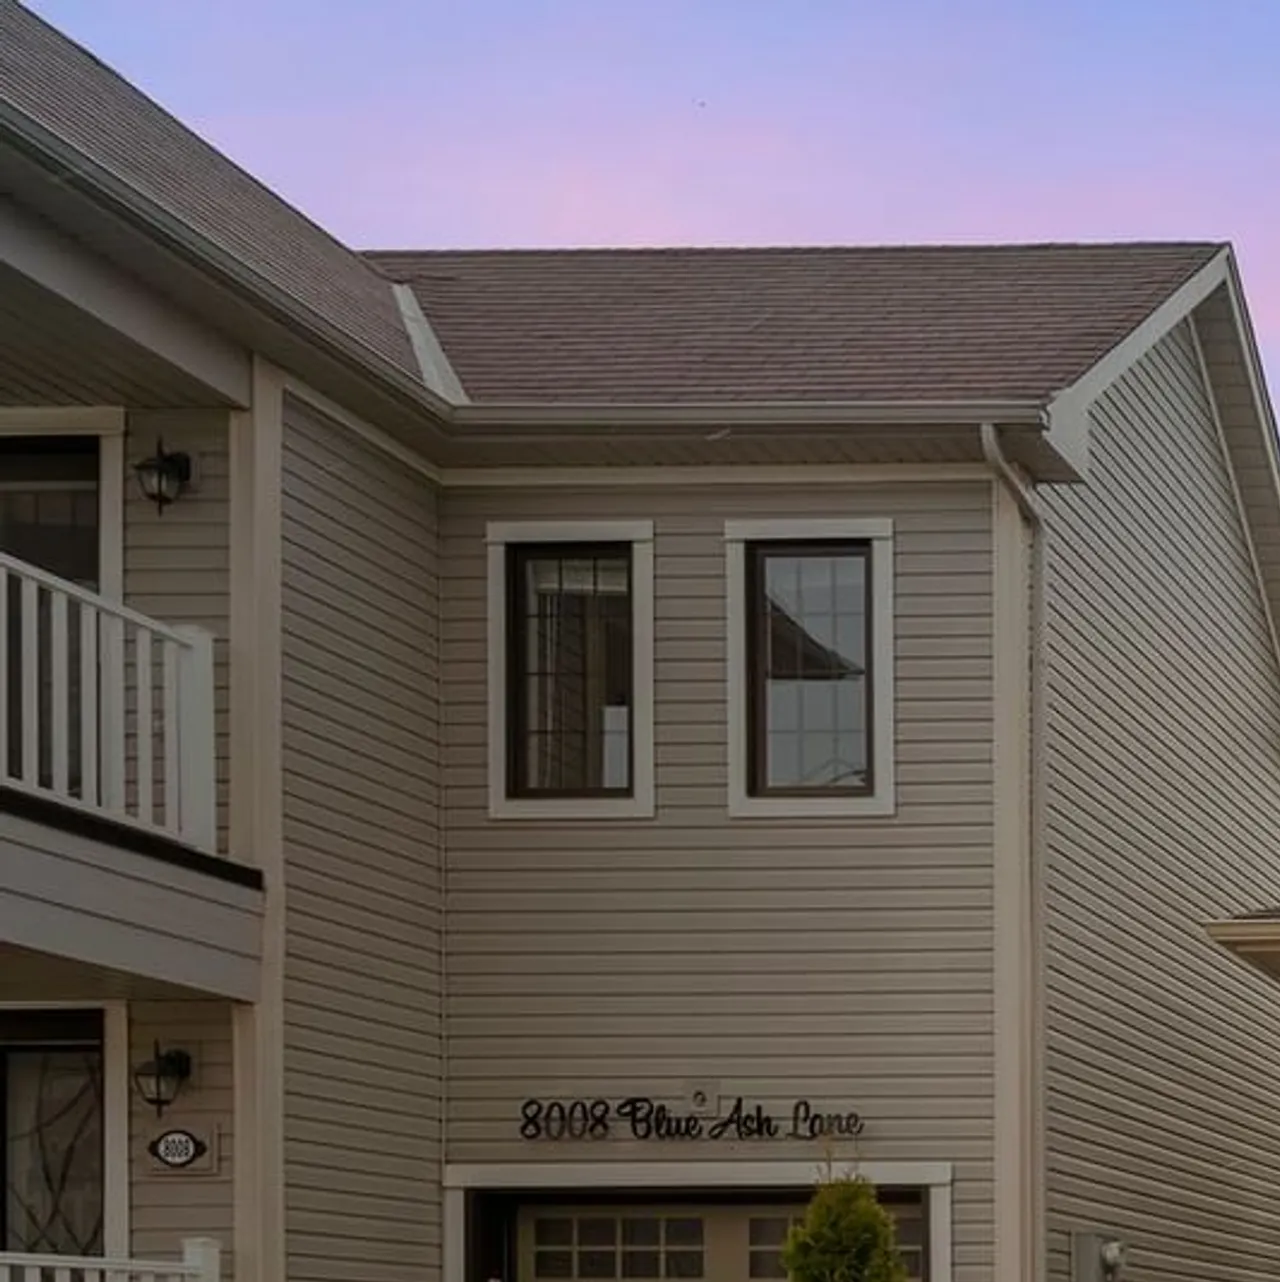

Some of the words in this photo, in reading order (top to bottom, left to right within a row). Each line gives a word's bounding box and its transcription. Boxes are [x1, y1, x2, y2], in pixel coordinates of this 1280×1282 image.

[520, 1100, 610, 1141] 8008
[616, 1097, 703, 1140] Blue
[708, 1097, 779, 1141] Ash
[786, 1100, 864, 1140] Lane
[163, 1138, 190, 1157] 8008
